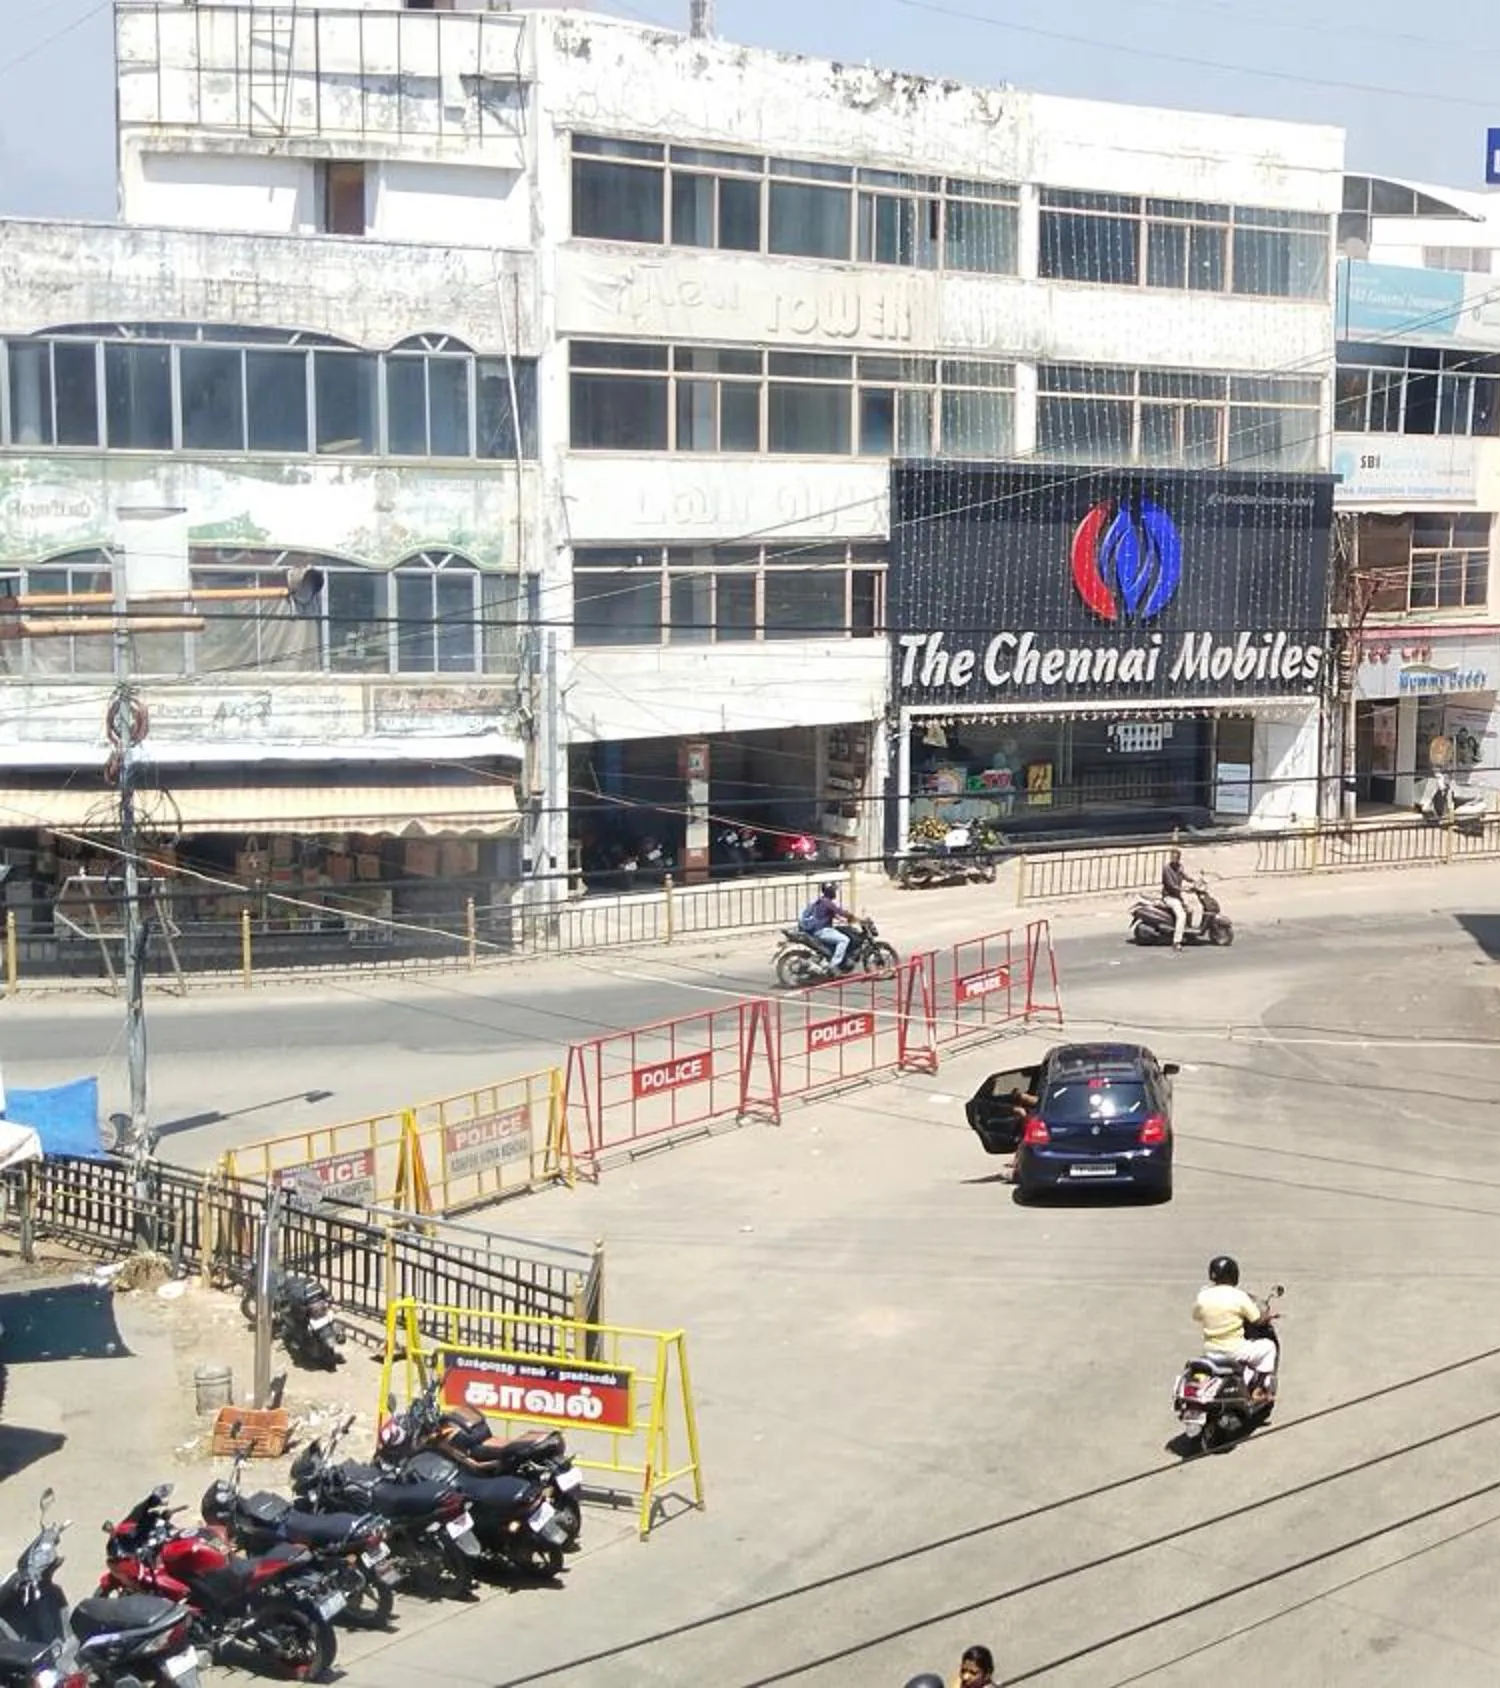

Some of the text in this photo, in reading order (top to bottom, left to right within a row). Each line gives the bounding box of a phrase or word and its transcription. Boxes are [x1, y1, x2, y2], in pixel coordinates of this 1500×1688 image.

[1360, 455, 1381, 469] SBI
[899, 630, 1323, 688] The Chennai Mobiles
[811, 1016, 866, 1047] POLICE
[641, 1058, 703, 1093] POLICE
[455, 1114, 523, 1150] POLICE
[464, 1380, 604, 1420] காவல்
